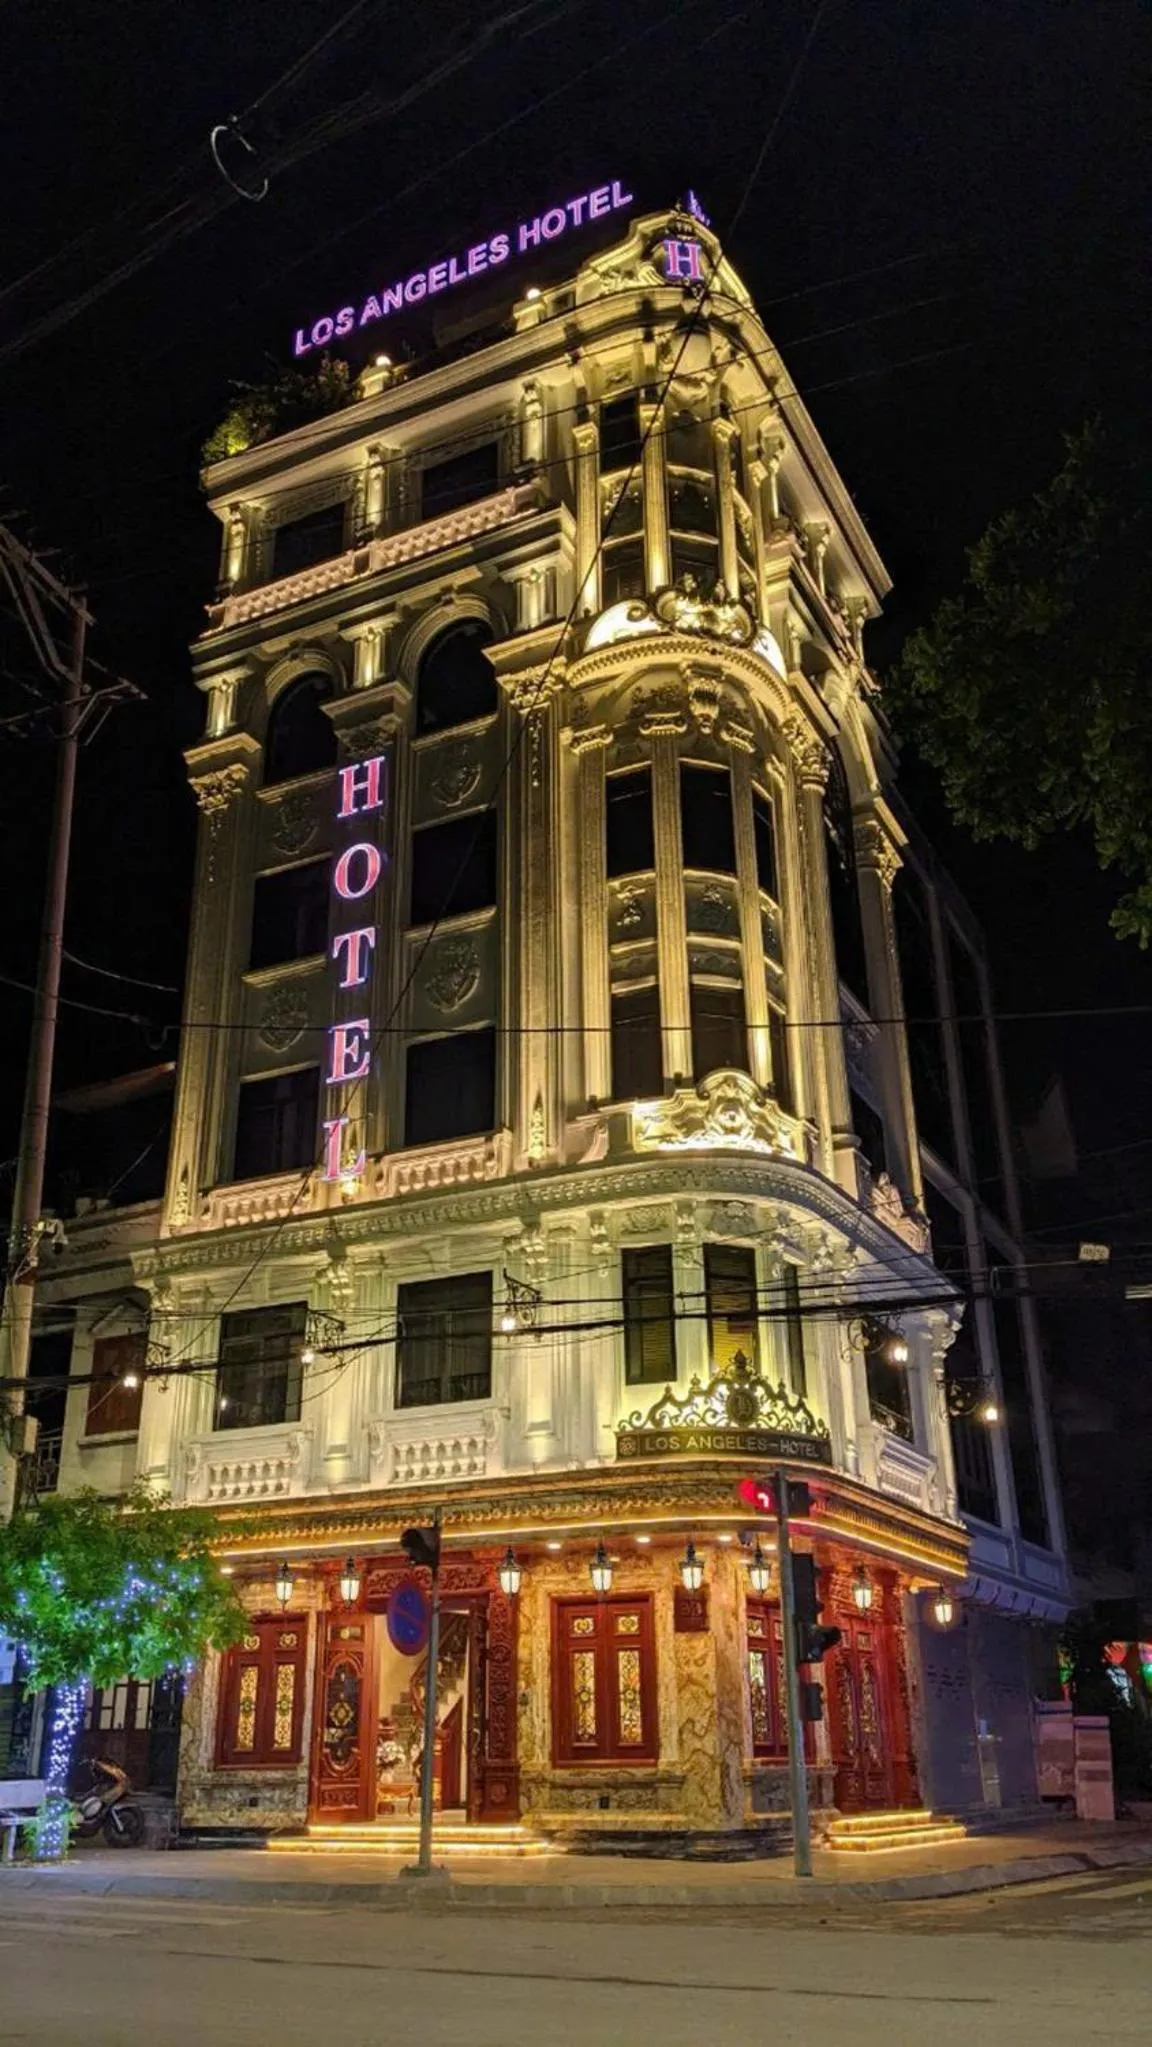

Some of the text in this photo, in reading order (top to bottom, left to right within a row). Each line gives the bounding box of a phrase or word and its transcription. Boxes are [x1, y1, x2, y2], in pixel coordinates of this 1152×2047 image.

[294, 306, 355, 356] LOS
[359, 233, 510, 326] ANGELES
[518, 180, 633, 252] HOTEL
[663, 239, 704, 281] H
[322, 755, 385, 1182] HOTEL
[644, 1435, 681, 1452] LOS
